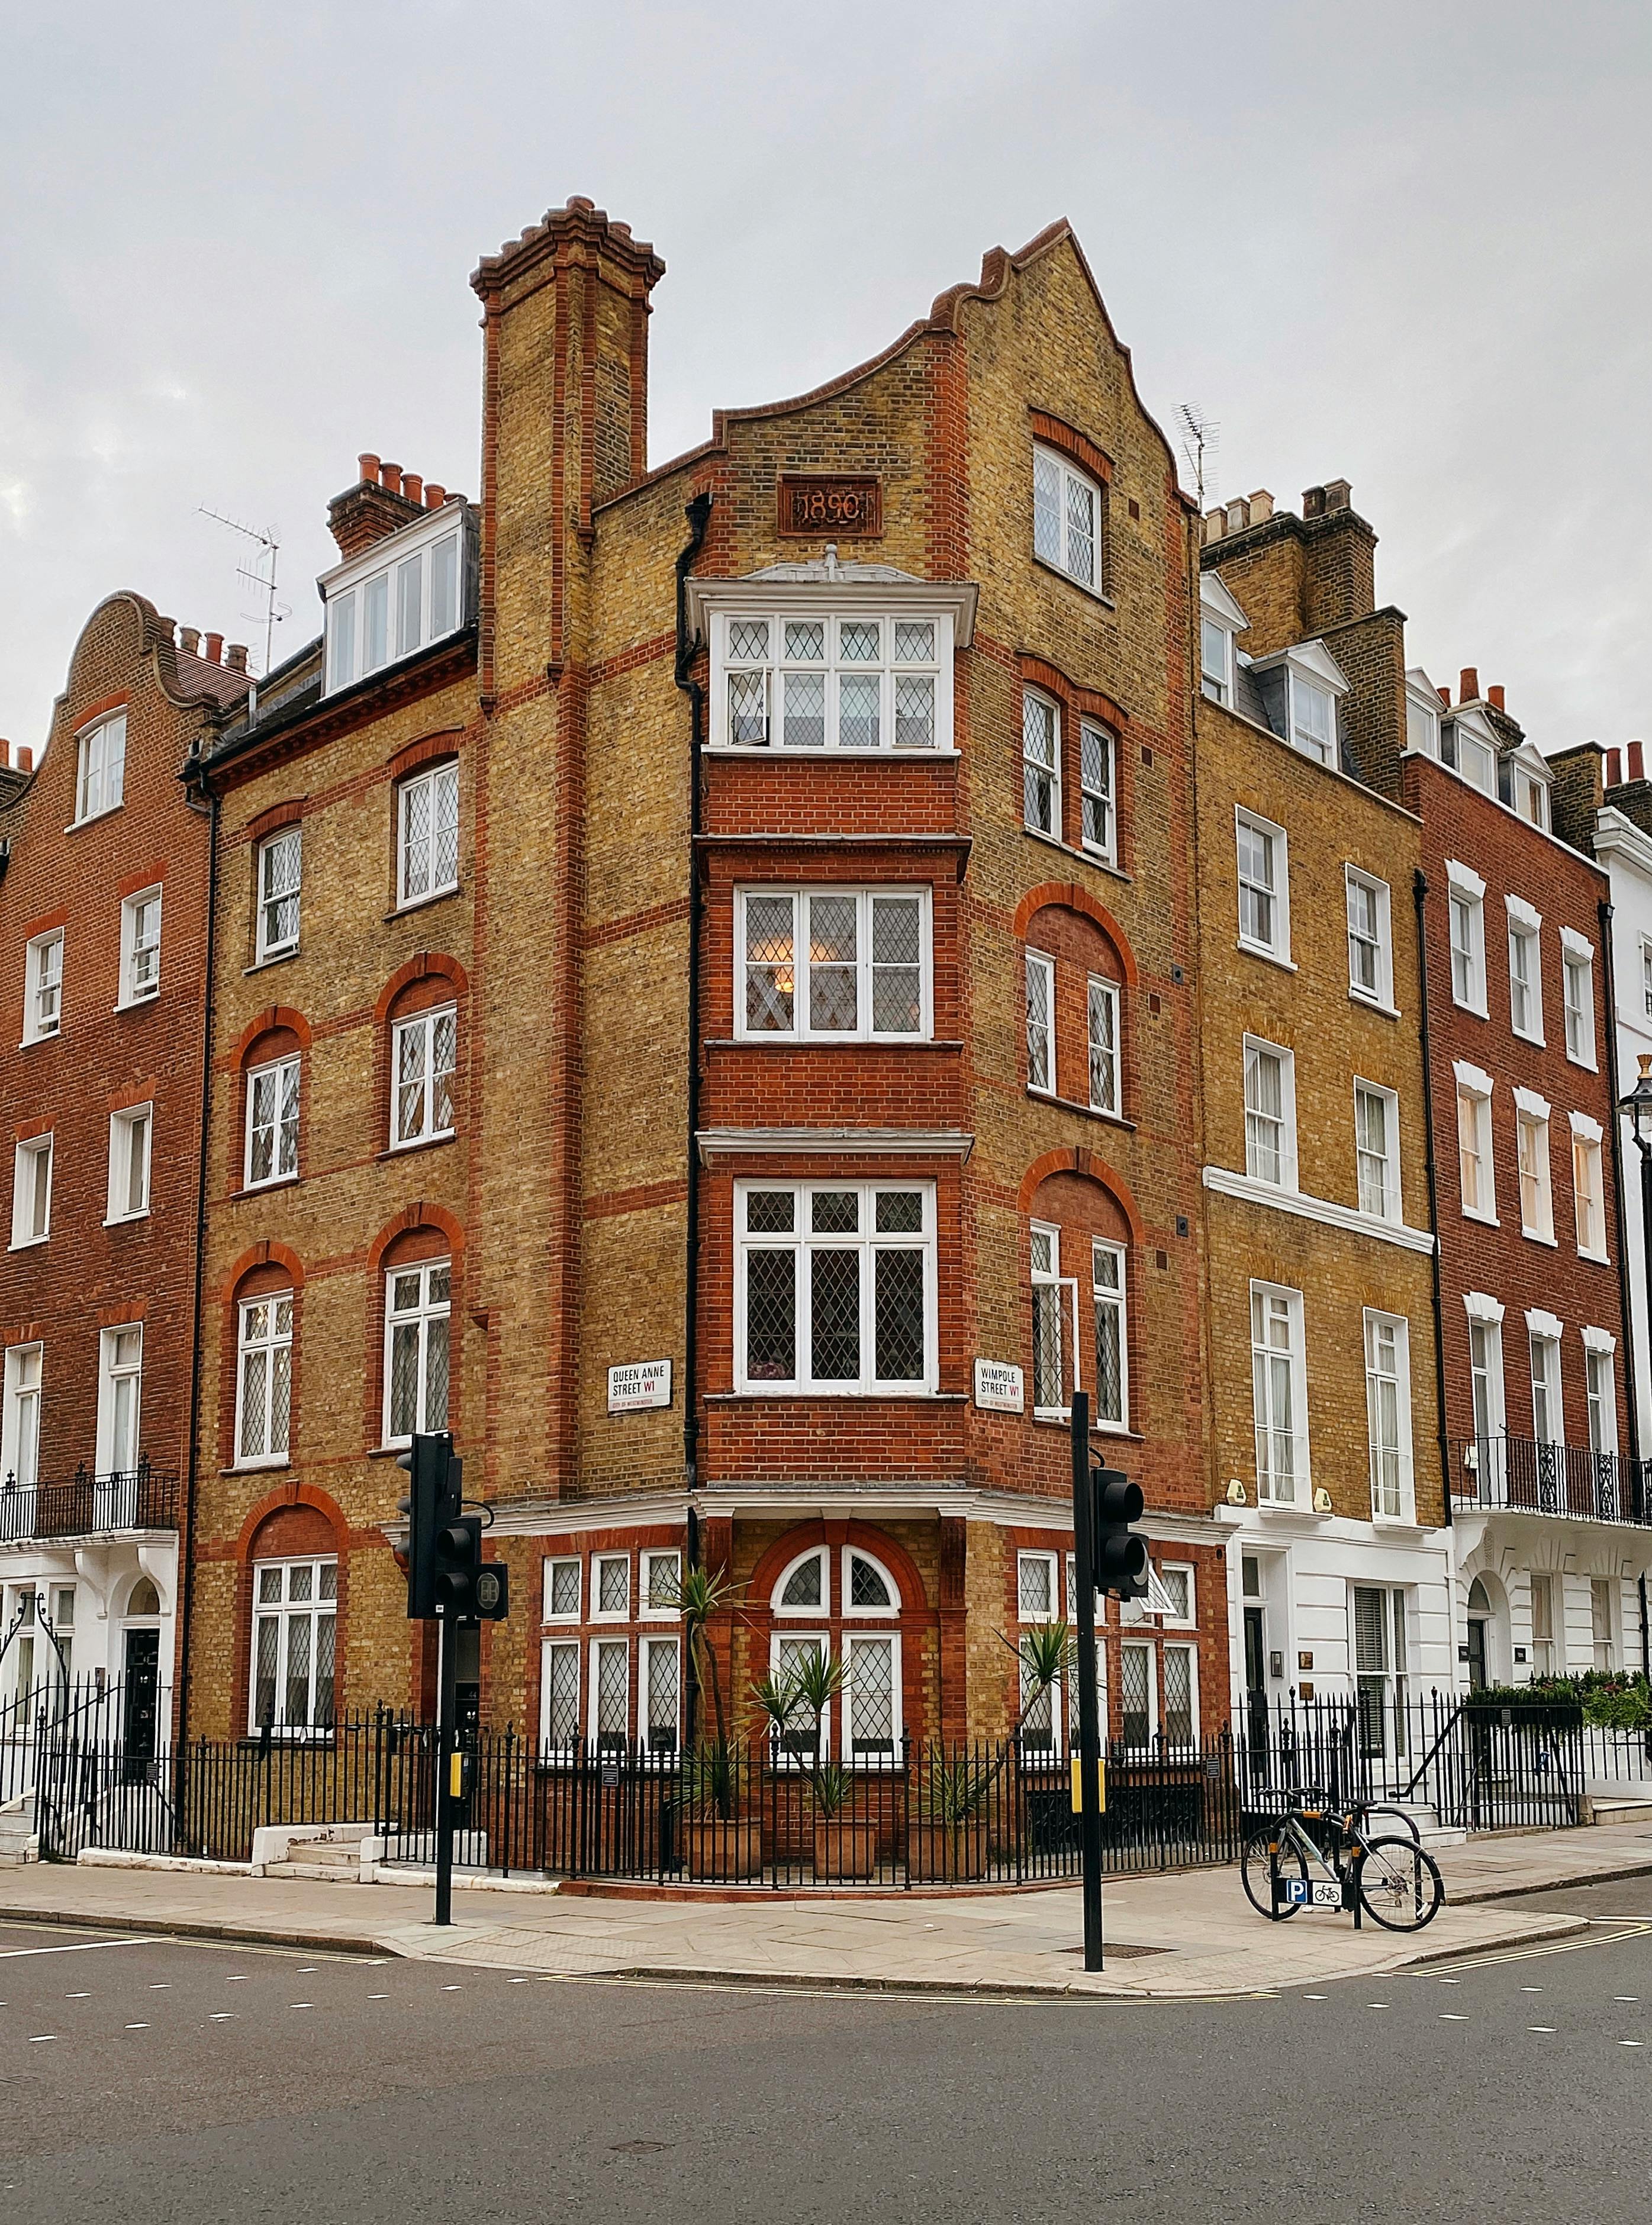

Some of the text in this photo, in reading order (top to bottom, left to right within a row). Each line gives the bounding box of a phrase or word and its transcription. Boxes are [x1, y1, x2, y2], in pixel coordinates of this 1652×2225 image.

[802, 494, 859, 519] 1890
[613, 1366, 664, 1383] QUEEN ANNE
[981, 1367, 1016, 1383] WIMPOLE
[613, 1380, 655, 1396] STREET W1
[981, 1381, 1019, 1398] STREET W1
[1291, 1882, 1304, 1901] P
